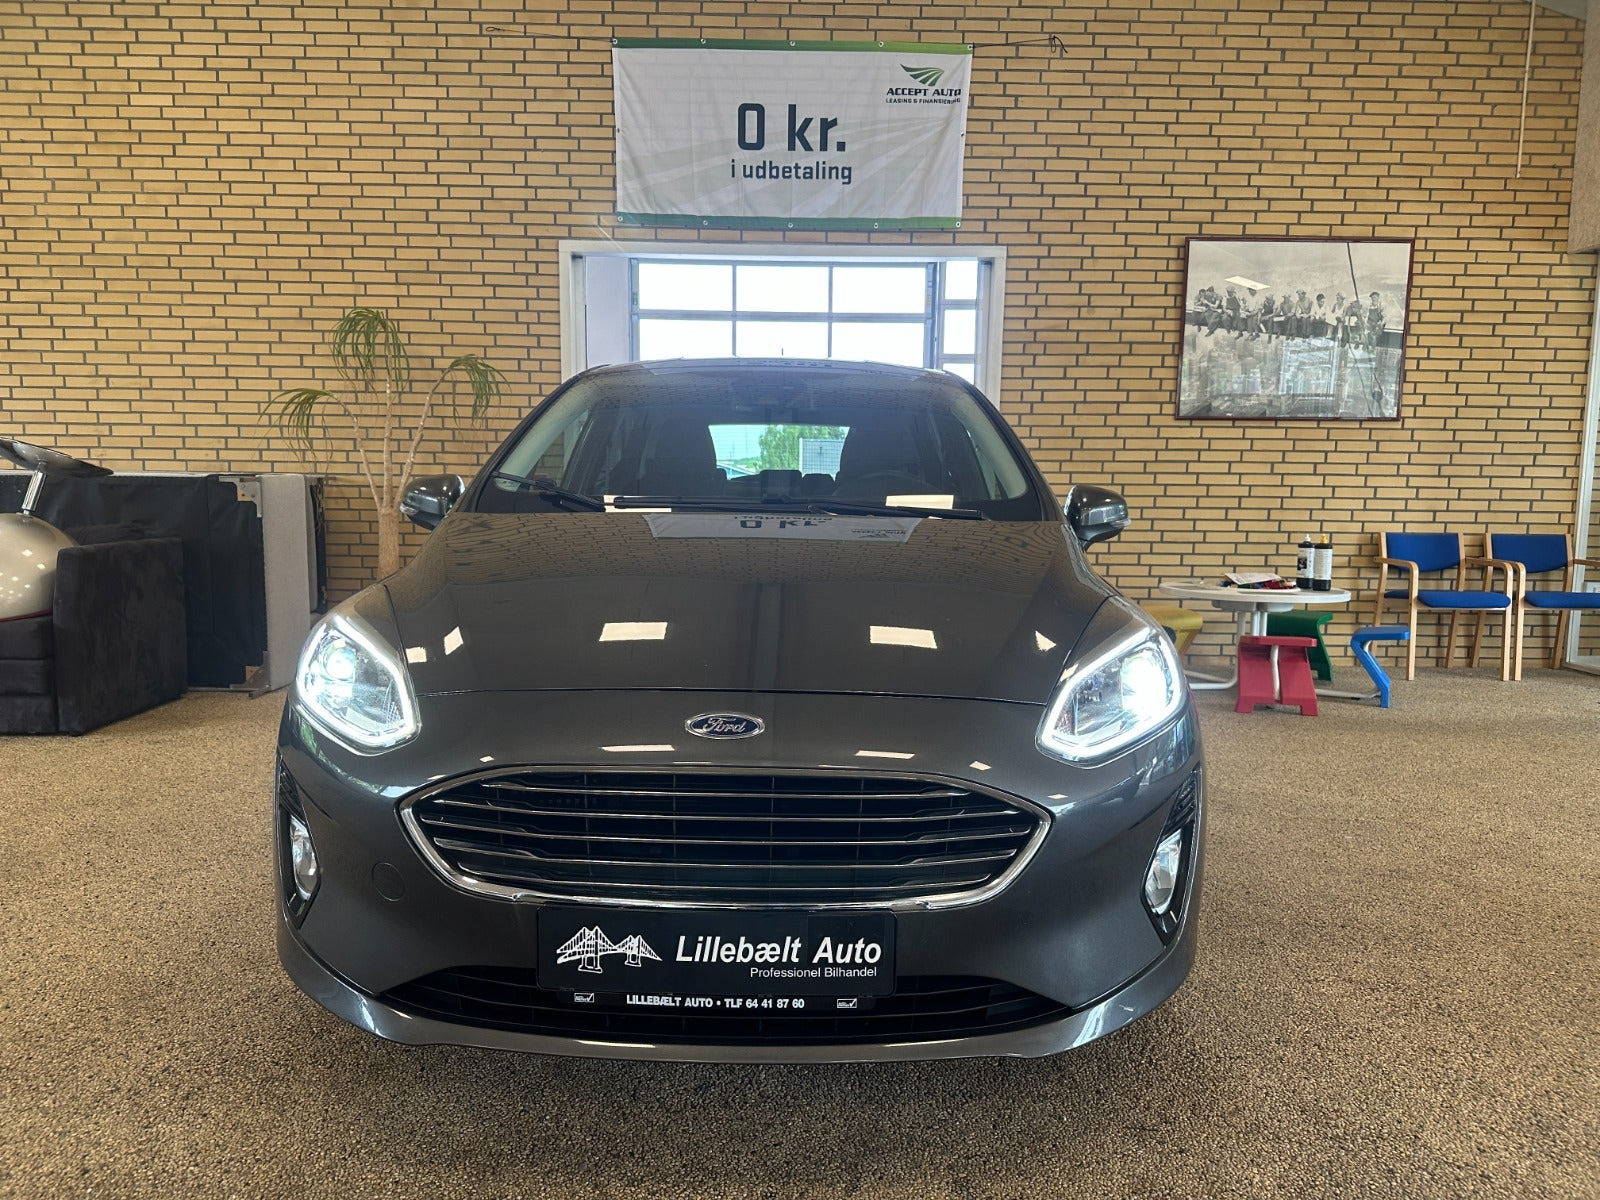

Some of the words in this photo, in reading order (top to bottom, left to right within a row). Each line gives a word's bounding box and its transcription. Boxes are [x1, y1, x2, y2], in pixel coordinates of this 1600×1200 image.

[886, 88, 929, 96] ACCEPT
[932, 88, 962, 97] AUTO
[737, 103, 765, 151] 0
[787, 104, 846, 152] kr.
[731, 159, 735, 178] i
[742, 160, 852, 185] udbetaling
[702, 717, 747, 733] Ford
[675, 936, 802, 963] Lillebælt
[811, 937, 882, 964] Auto
[750, 967, 821, 978] Professionel
[824, 967, 877, 977] Bilhandel
[626, 994, 682, 1007] LILLEBÆLT
[684, 997, 713, 1008] AUTO
[724, 998, 743, 1008] TLF
[745, 998, 759, 1008] 64
[761, 998, 773, 1008] 41
[776, 998, 789, 1008] 87
[792, 998, 805, 1008] 60
